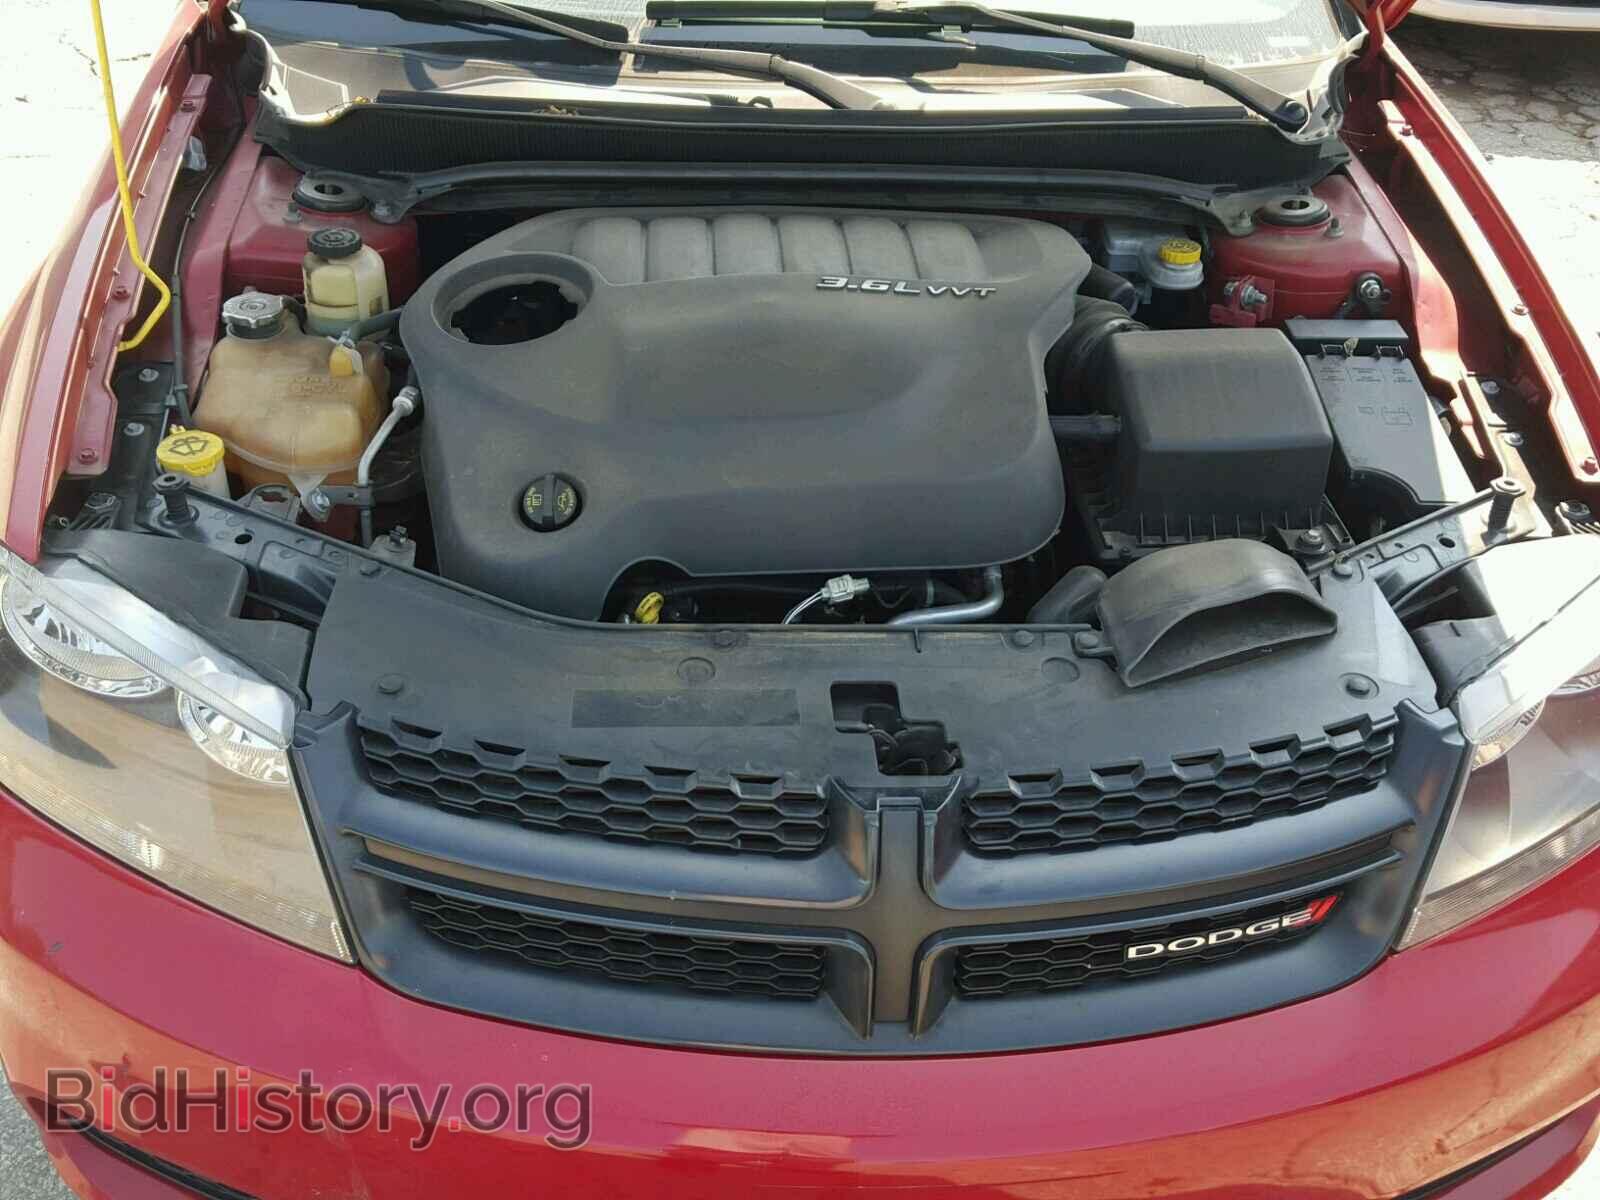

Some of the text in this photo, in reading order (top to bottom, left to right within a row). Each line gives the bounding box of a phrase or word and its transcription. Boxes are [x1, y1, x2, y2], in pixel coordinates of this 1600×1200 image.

[816, 276, 997, 297] 3.6L VVT
[1127, 908, 1313, 959] DODGE
